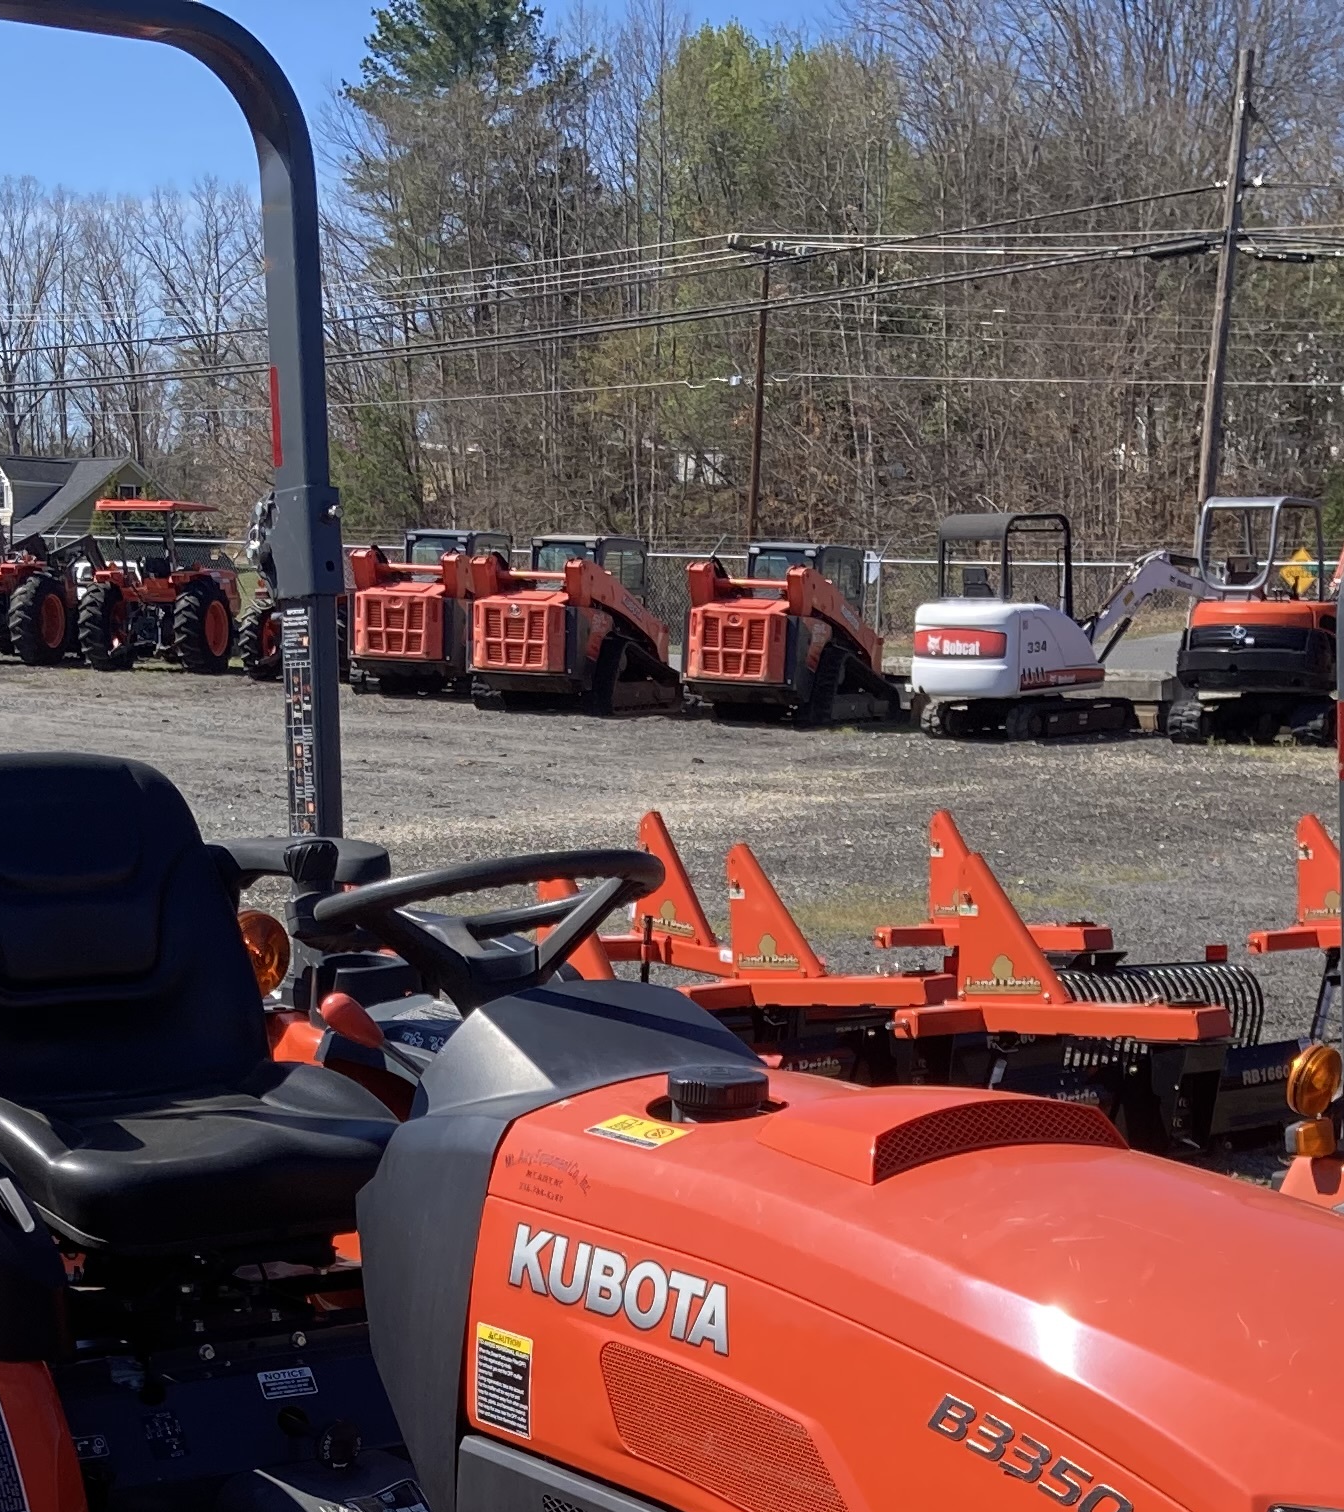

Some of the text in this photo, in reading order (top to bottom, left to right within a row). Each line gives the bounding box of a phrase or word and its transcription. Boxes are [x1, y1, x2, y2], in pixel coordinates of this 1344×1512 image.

[942, 640, 980, 656] Bobcat
[1027, 641, 1048, 654] 334
[508, 1222, 730, 1357] KUBOTA
[263, 1368, 305, 1380] NOTICE
